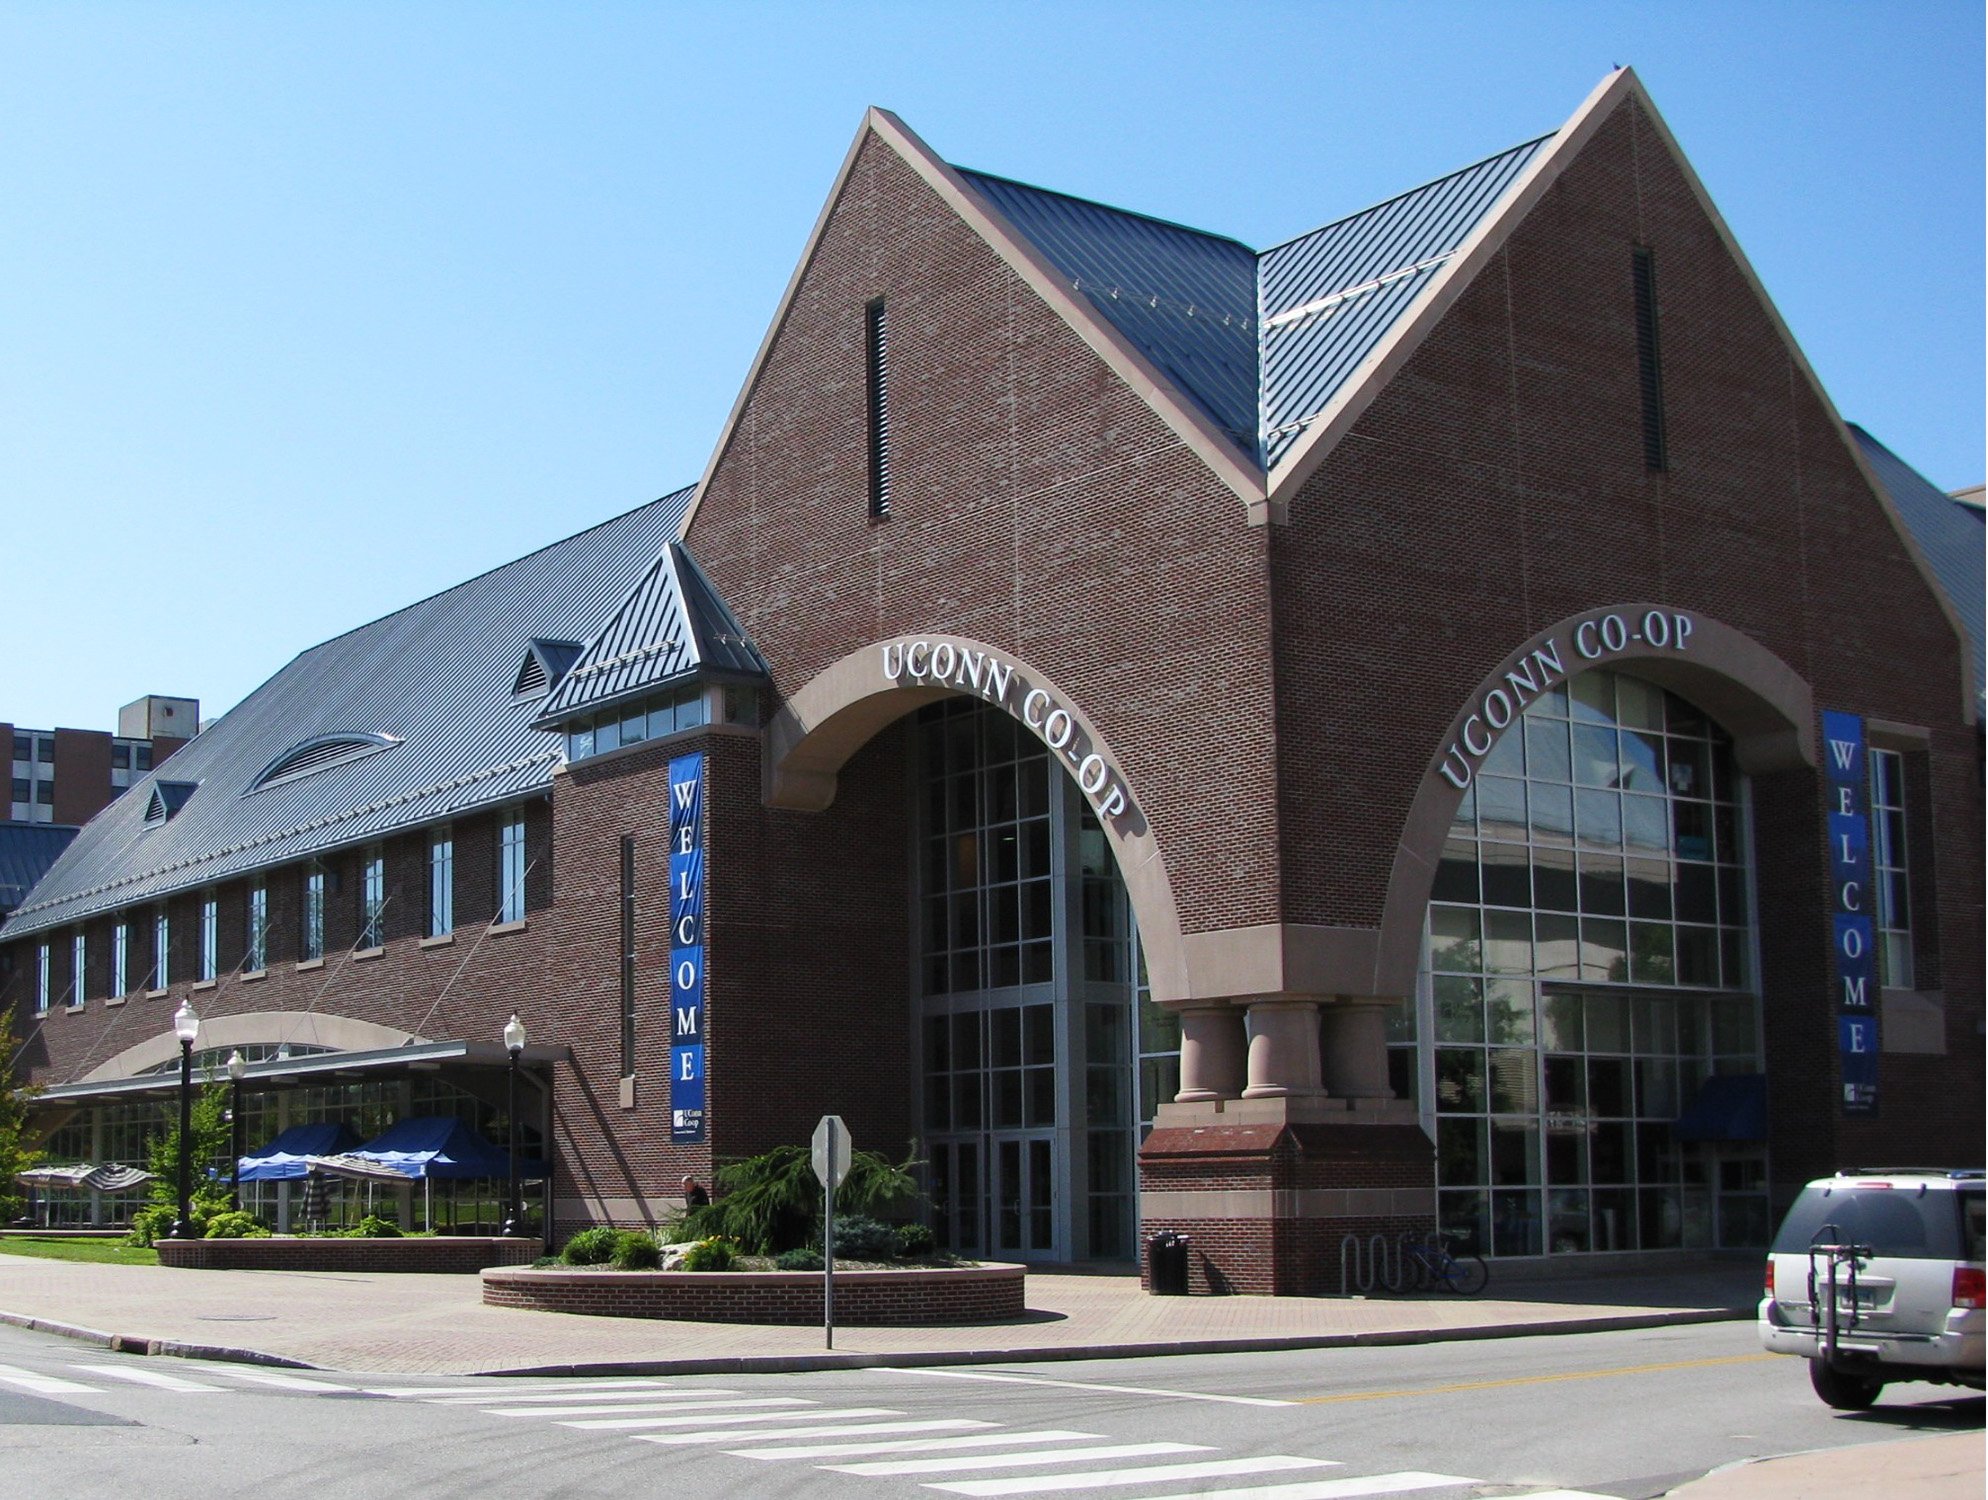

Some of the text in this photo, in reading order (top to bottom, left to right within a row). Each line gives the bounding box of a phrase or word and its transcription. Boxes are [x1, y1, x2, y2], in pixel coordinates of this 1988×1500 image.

[882, 641, 1125, 822] UCONN CO-OP
[1438, 610, 1693, 789] UCONN CO-OP
[673, 779, 698, 1081] WELCOME
[1829, 739, 1867, 1054] WELCOME
